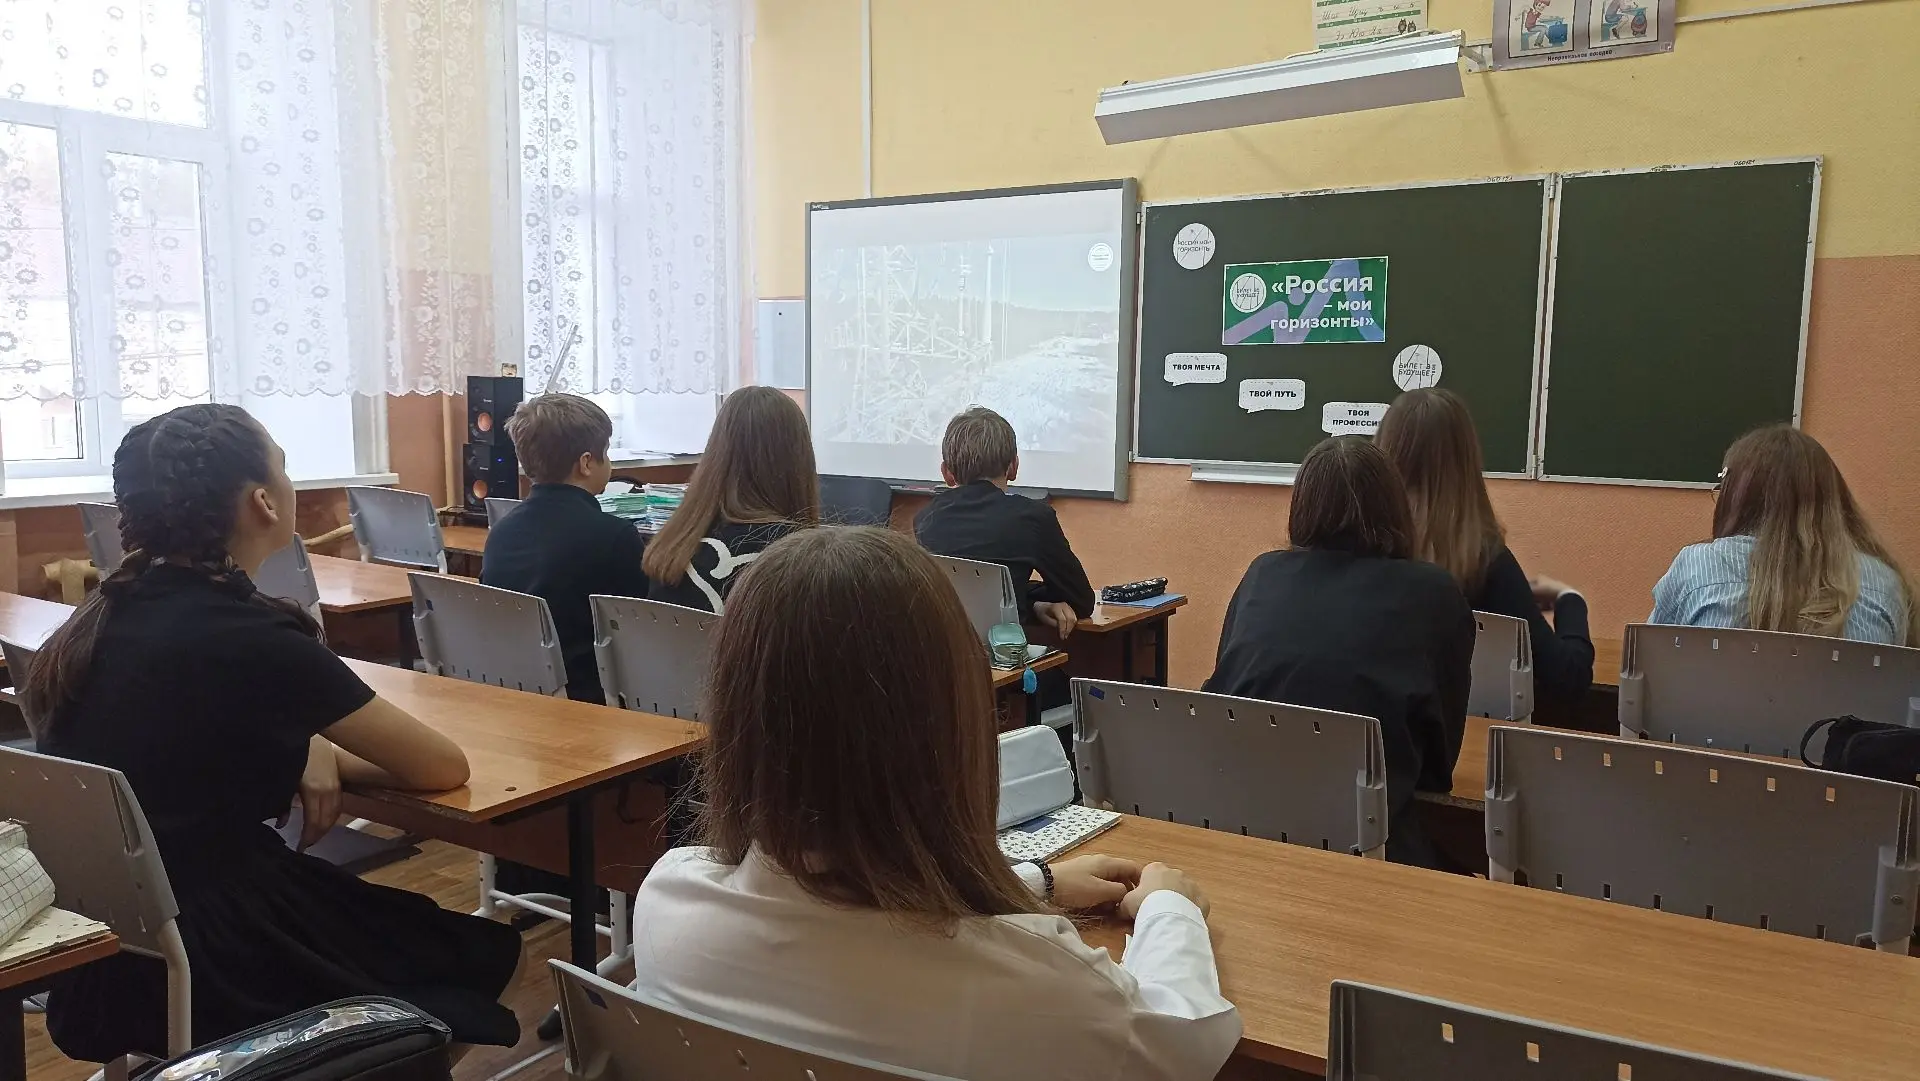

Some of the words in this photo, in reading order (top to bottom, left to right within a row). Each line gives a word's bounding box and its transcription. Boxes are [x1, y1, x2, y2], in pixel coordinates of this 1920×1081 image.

[1271, 275, 1373, 296] «Россия
[1337, 300, 1372, 312] мои
[1270, 316, 1375, 333] горизонты»
[1398, 362, 1424, 370] БИЛЕТ
[1249, 389, 1272, 398] ТВОЙ
[1274, 390, 1297, 398] ПУТЬ
[1347, 409, 1370, 417] ТВОЯ
